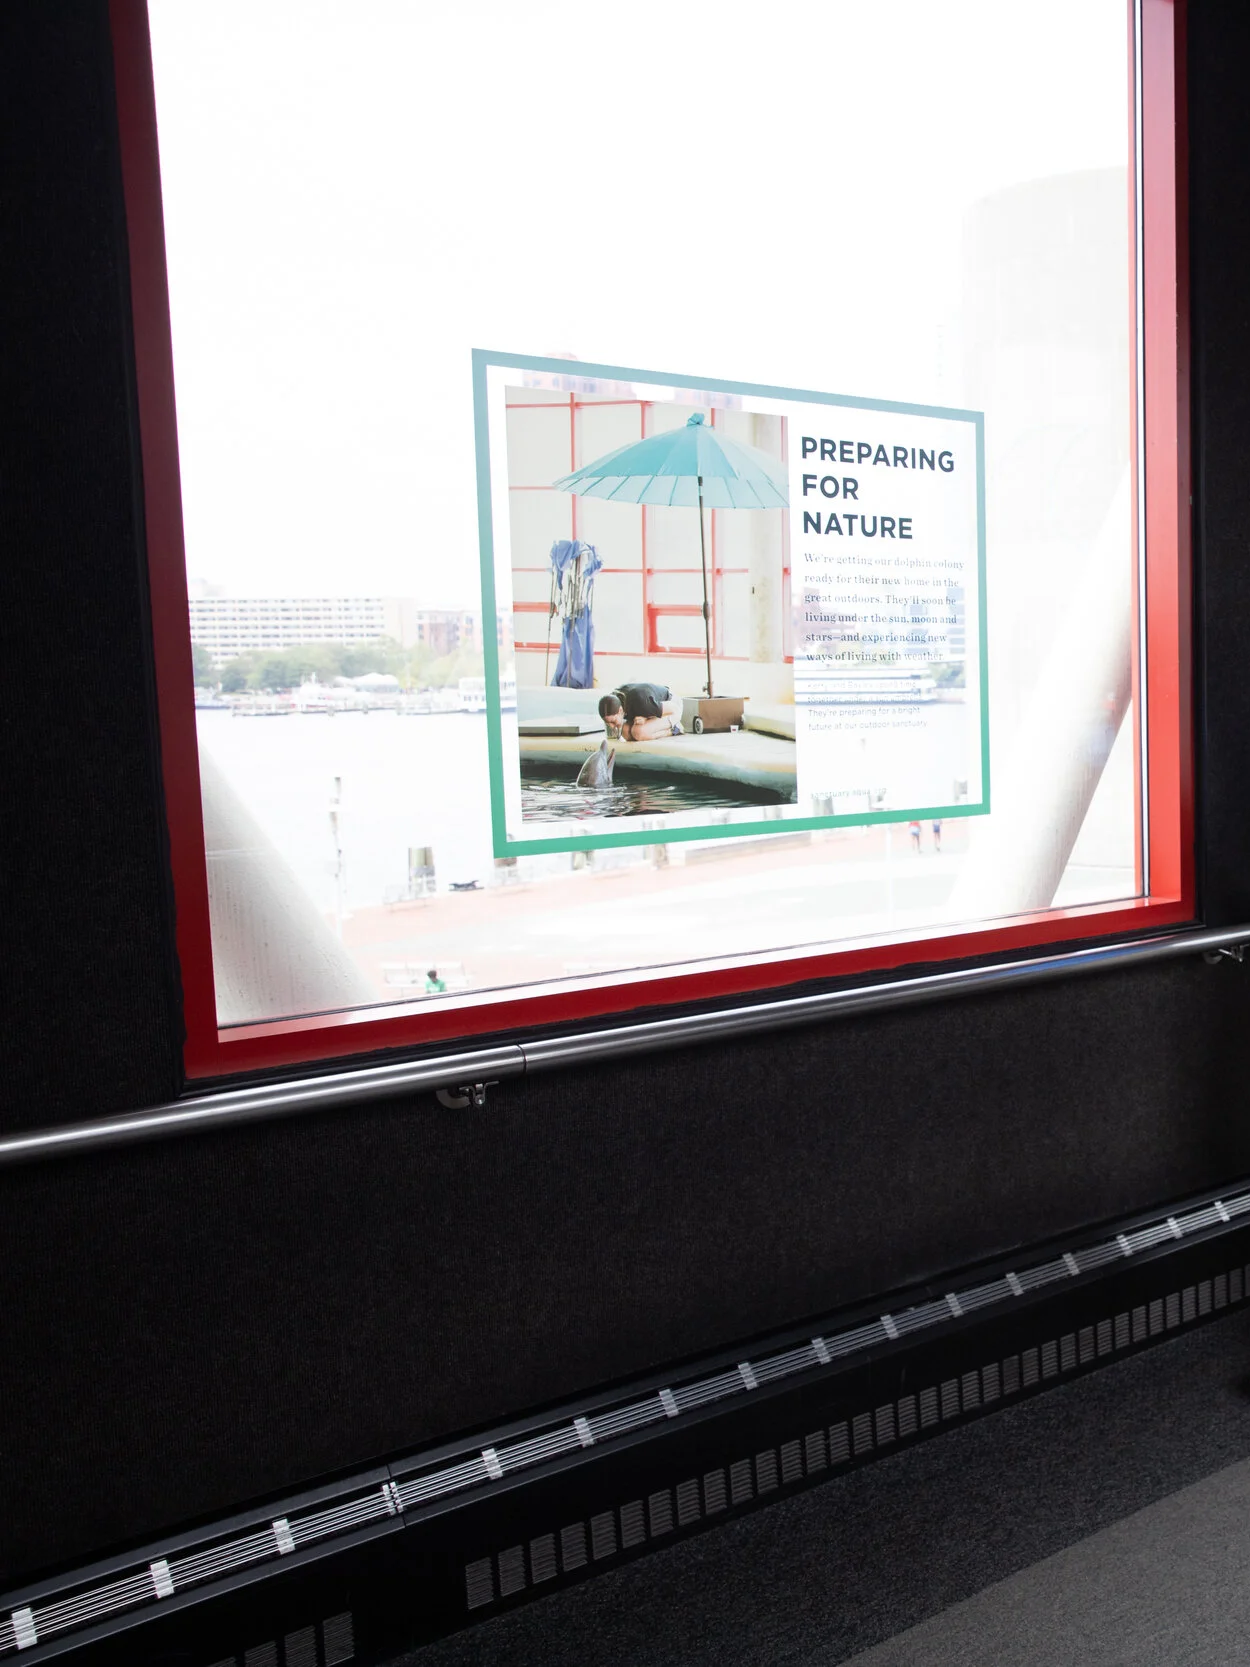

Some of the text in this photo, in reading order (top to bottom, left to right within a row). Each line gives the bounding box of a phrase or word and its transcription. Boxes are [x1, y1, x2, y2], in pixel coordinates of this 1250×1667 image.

[801, 436, 955, 473] PREPARING
[802, 474, 859, 500] FOR
[803, 511, 913, 540] NATURE
[804, 552, 965, 571] We're getting our dolphin colony
[804, 573, 960, 588] ready for their new home in the
[804, 593, 957, 606] great outdoors. They'll soon be
[805, 612, 836, 624] living
[838, 612, 868, 623] under
[870, 613, 888, 623] the
[911, 616, 938, 624] moon
[940, 615, 957, 624] and
[861, 633, 927, 645] experiencing
[928, 634, 947, 643] new
[806, 652, 833, 664] ways
[835, 652, 846, 661] of
[847, 652, 877, 663] living
[879, 652, 902, 661] with
[808, 709, 837, 718] They're
[839, 707, 877, 718] preparing
[878, 706, 889, 715] for
[898, 706, 921, 716] bright
[808, 723, 832, 732] future
[834, 722, 842, 730] at
[860, 720, 890, 729] outdoor
